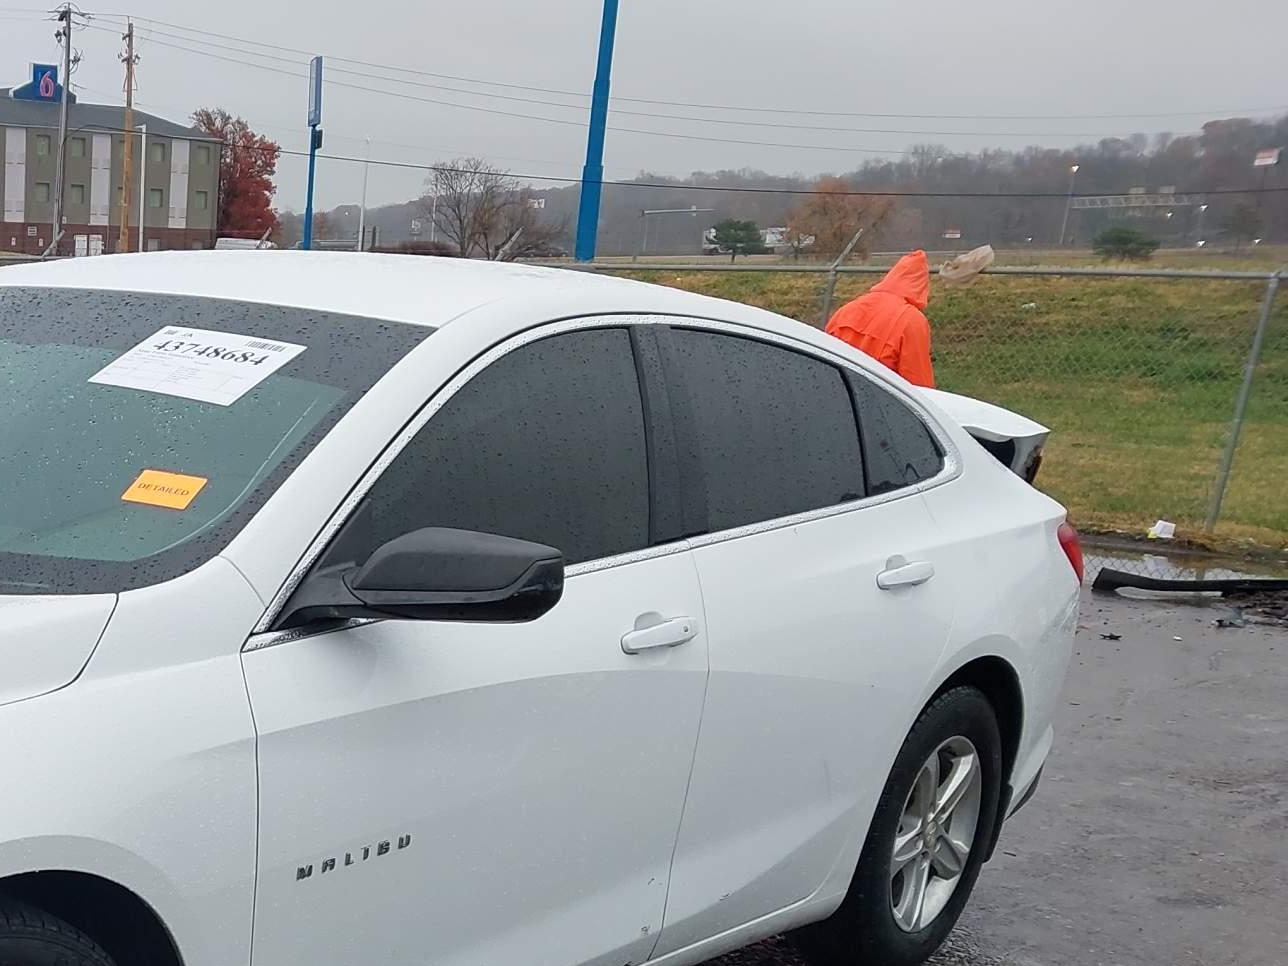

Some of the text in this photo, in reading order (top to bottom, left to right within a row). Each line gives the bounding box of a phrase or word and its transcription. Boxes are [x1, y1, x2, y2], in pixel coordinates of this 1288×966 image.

[40, 70, 54, 97] 6
[153, 339, 269, 366] 43748684
[138, 482, 190, 496] DETAILED
[296, 834, 411, 881] MALIBU
